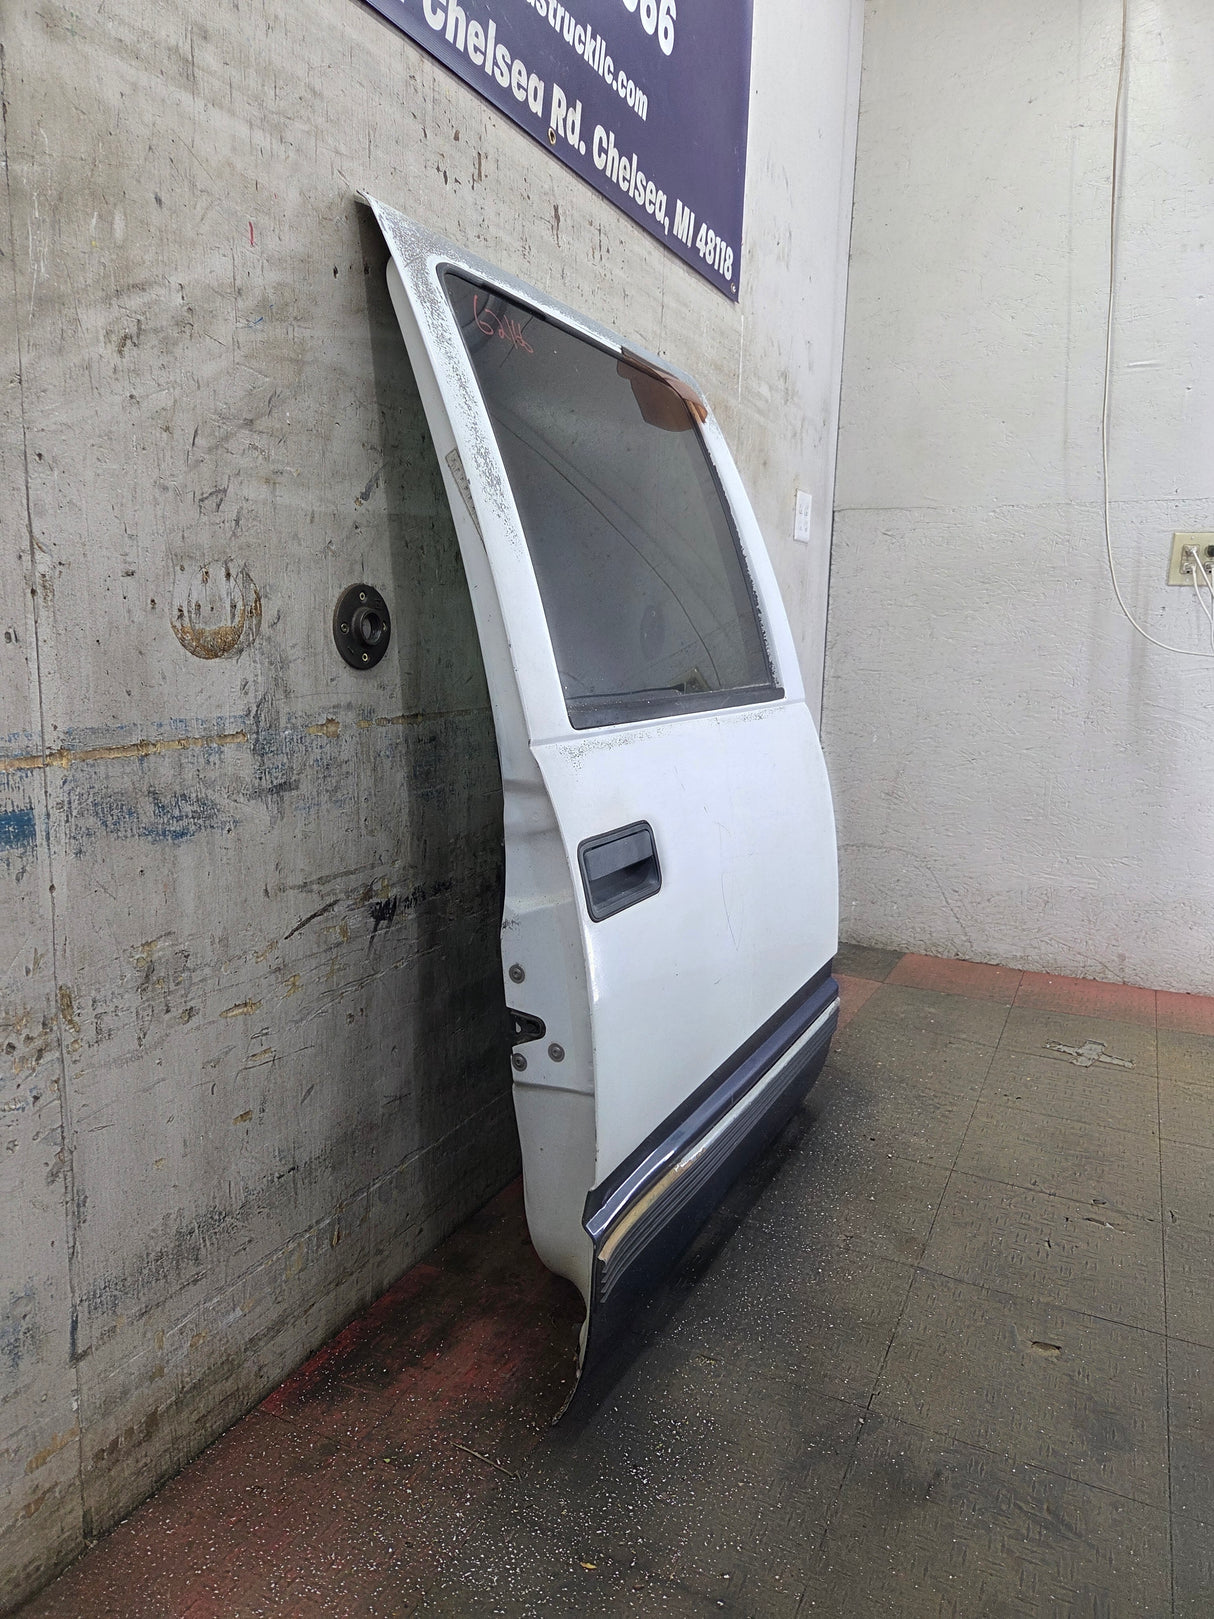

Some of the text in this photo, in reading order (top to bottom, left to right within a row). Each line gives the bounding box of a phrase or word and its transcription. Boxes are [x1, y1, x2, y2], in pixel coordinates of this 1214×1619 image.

[526, 0, 649, 121] struckllc.com
[622, 0, 677, 56] 66
[422, 0, 734, 281] Chelsea Rd. Chelsea, MI 48118
